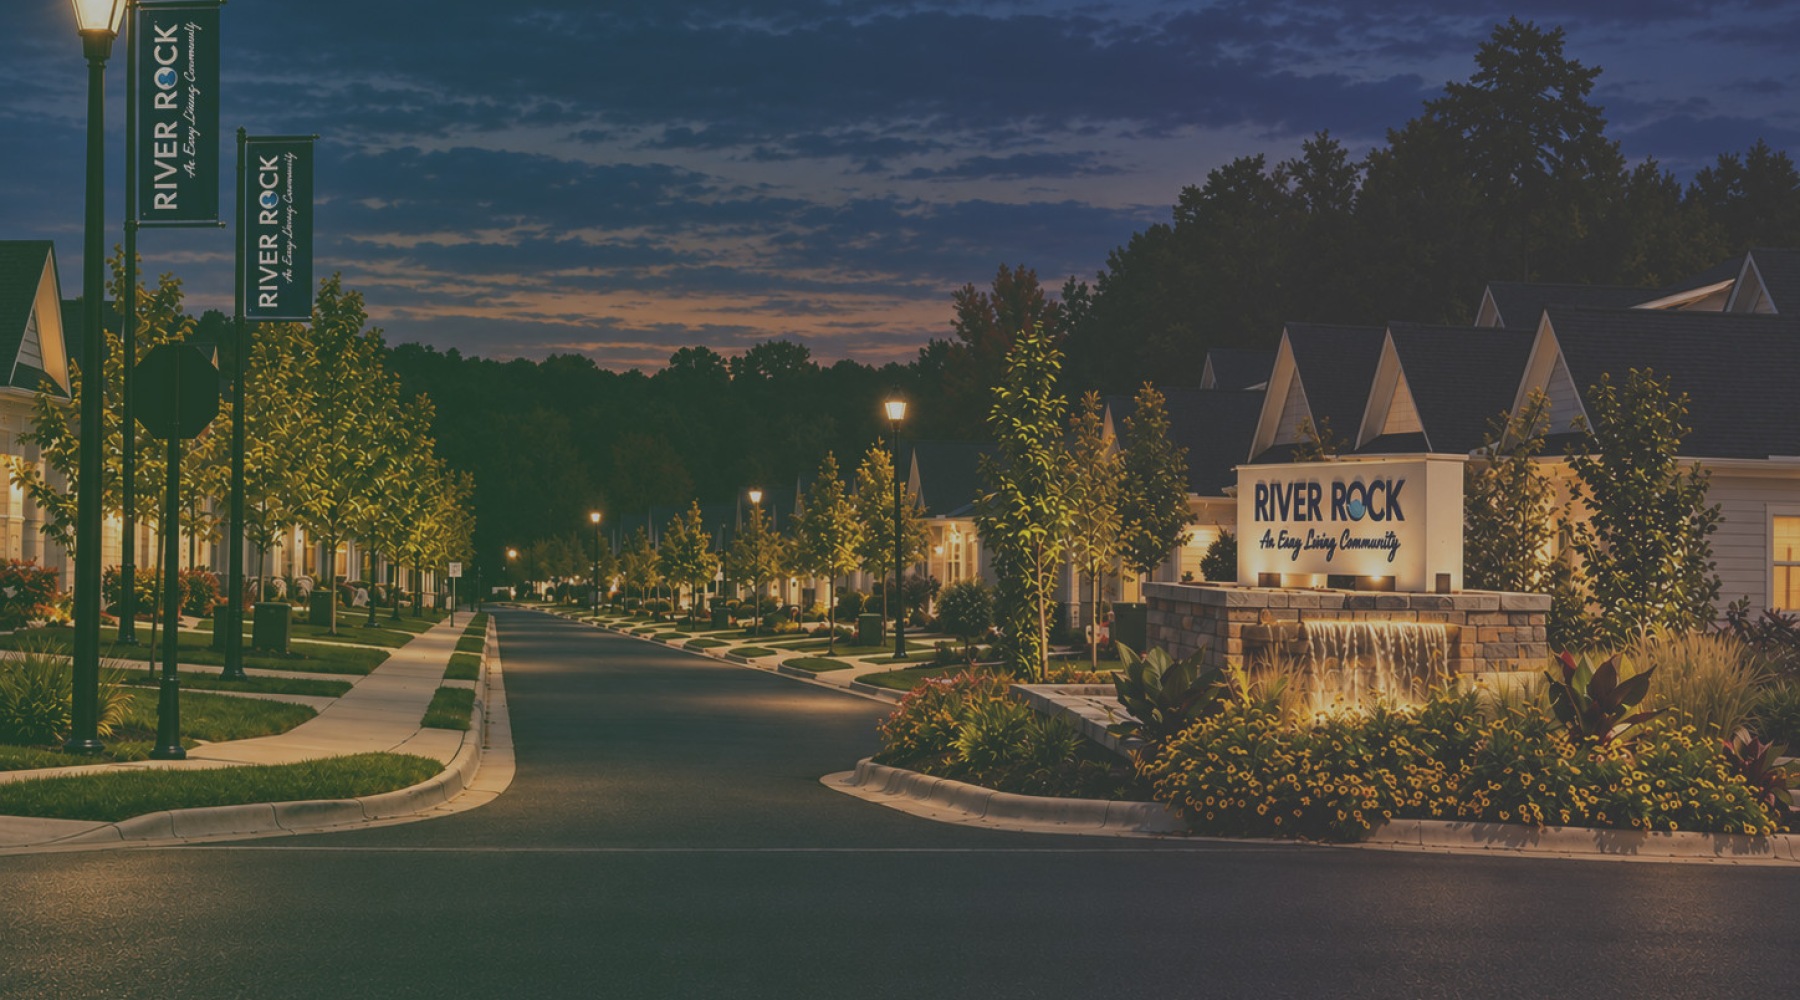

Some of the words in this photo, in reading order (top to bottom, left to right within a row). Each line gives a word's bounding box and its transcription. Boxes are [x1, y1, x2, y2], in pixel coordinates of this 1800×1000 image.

[154, 24, 179, 109] ROCK
[154, 121, 178, 210] RIVER
[259, 155, 279, 225] ROCK
[259, 234, 278, 308] RIVER
[1254, 482, 1322, 522] RIVER
[1331, 478, 1405, 522] ROCK
[1260, 528, 1275, 549] An
[1304, 528, 1337, 562] Living
[1340, 528, 1401, 563] Community
